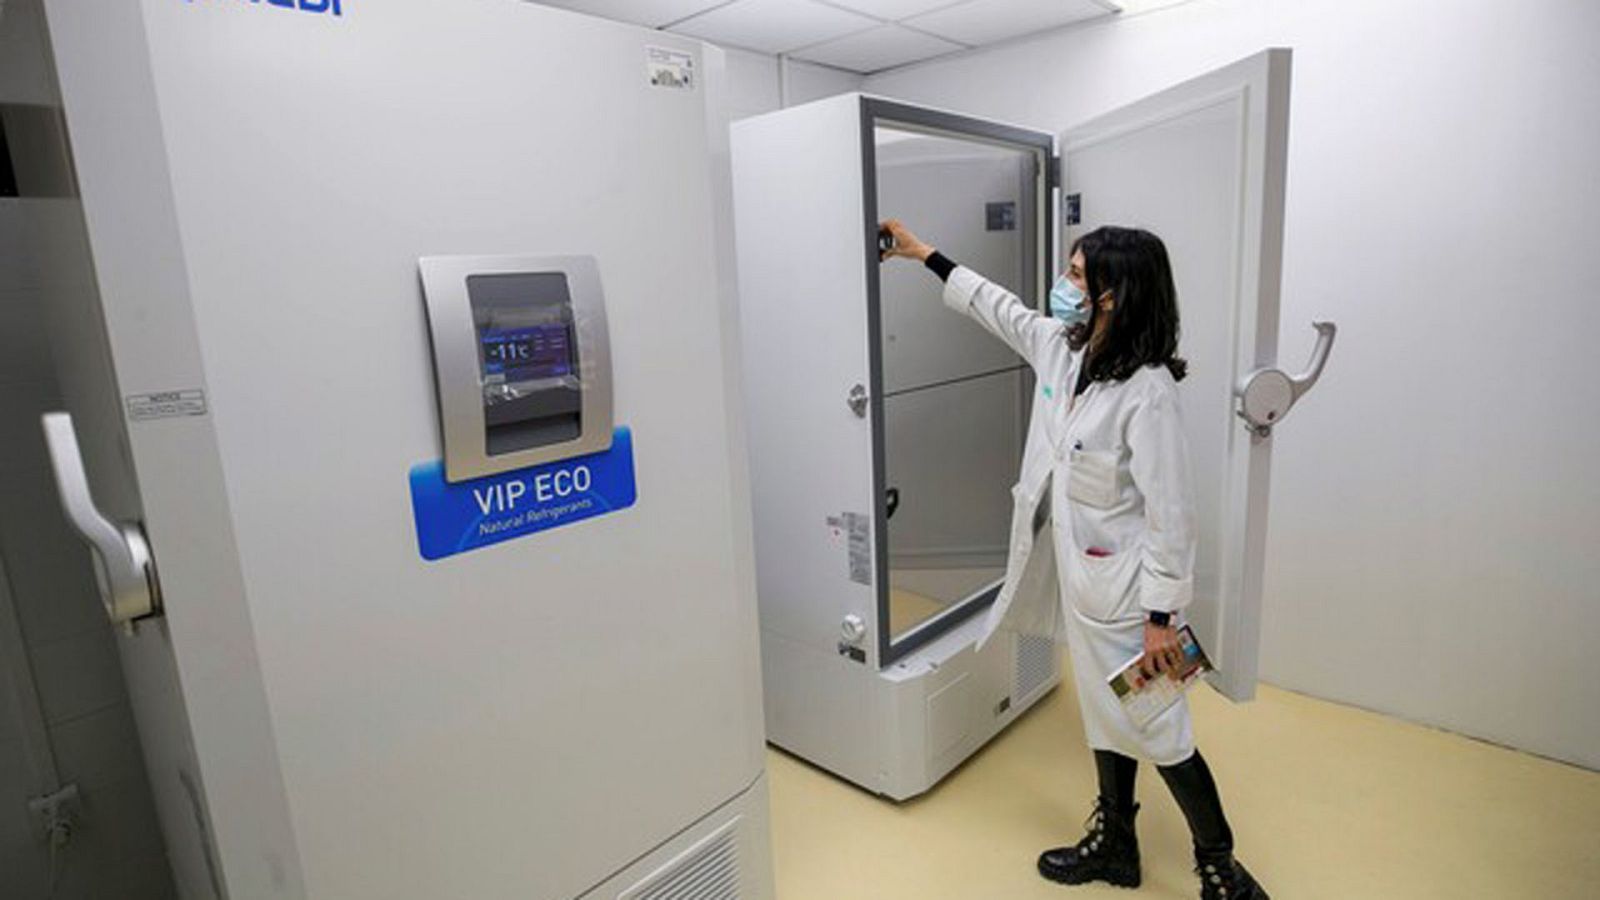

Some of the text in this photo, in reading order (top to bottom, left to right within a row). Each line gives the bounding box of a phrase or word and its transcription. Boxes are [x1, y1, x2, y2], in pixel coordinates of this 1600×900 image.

[473, 465, 592, 516] VIP ECO
[479, 499, 593, 536] Natural Refrigerants
